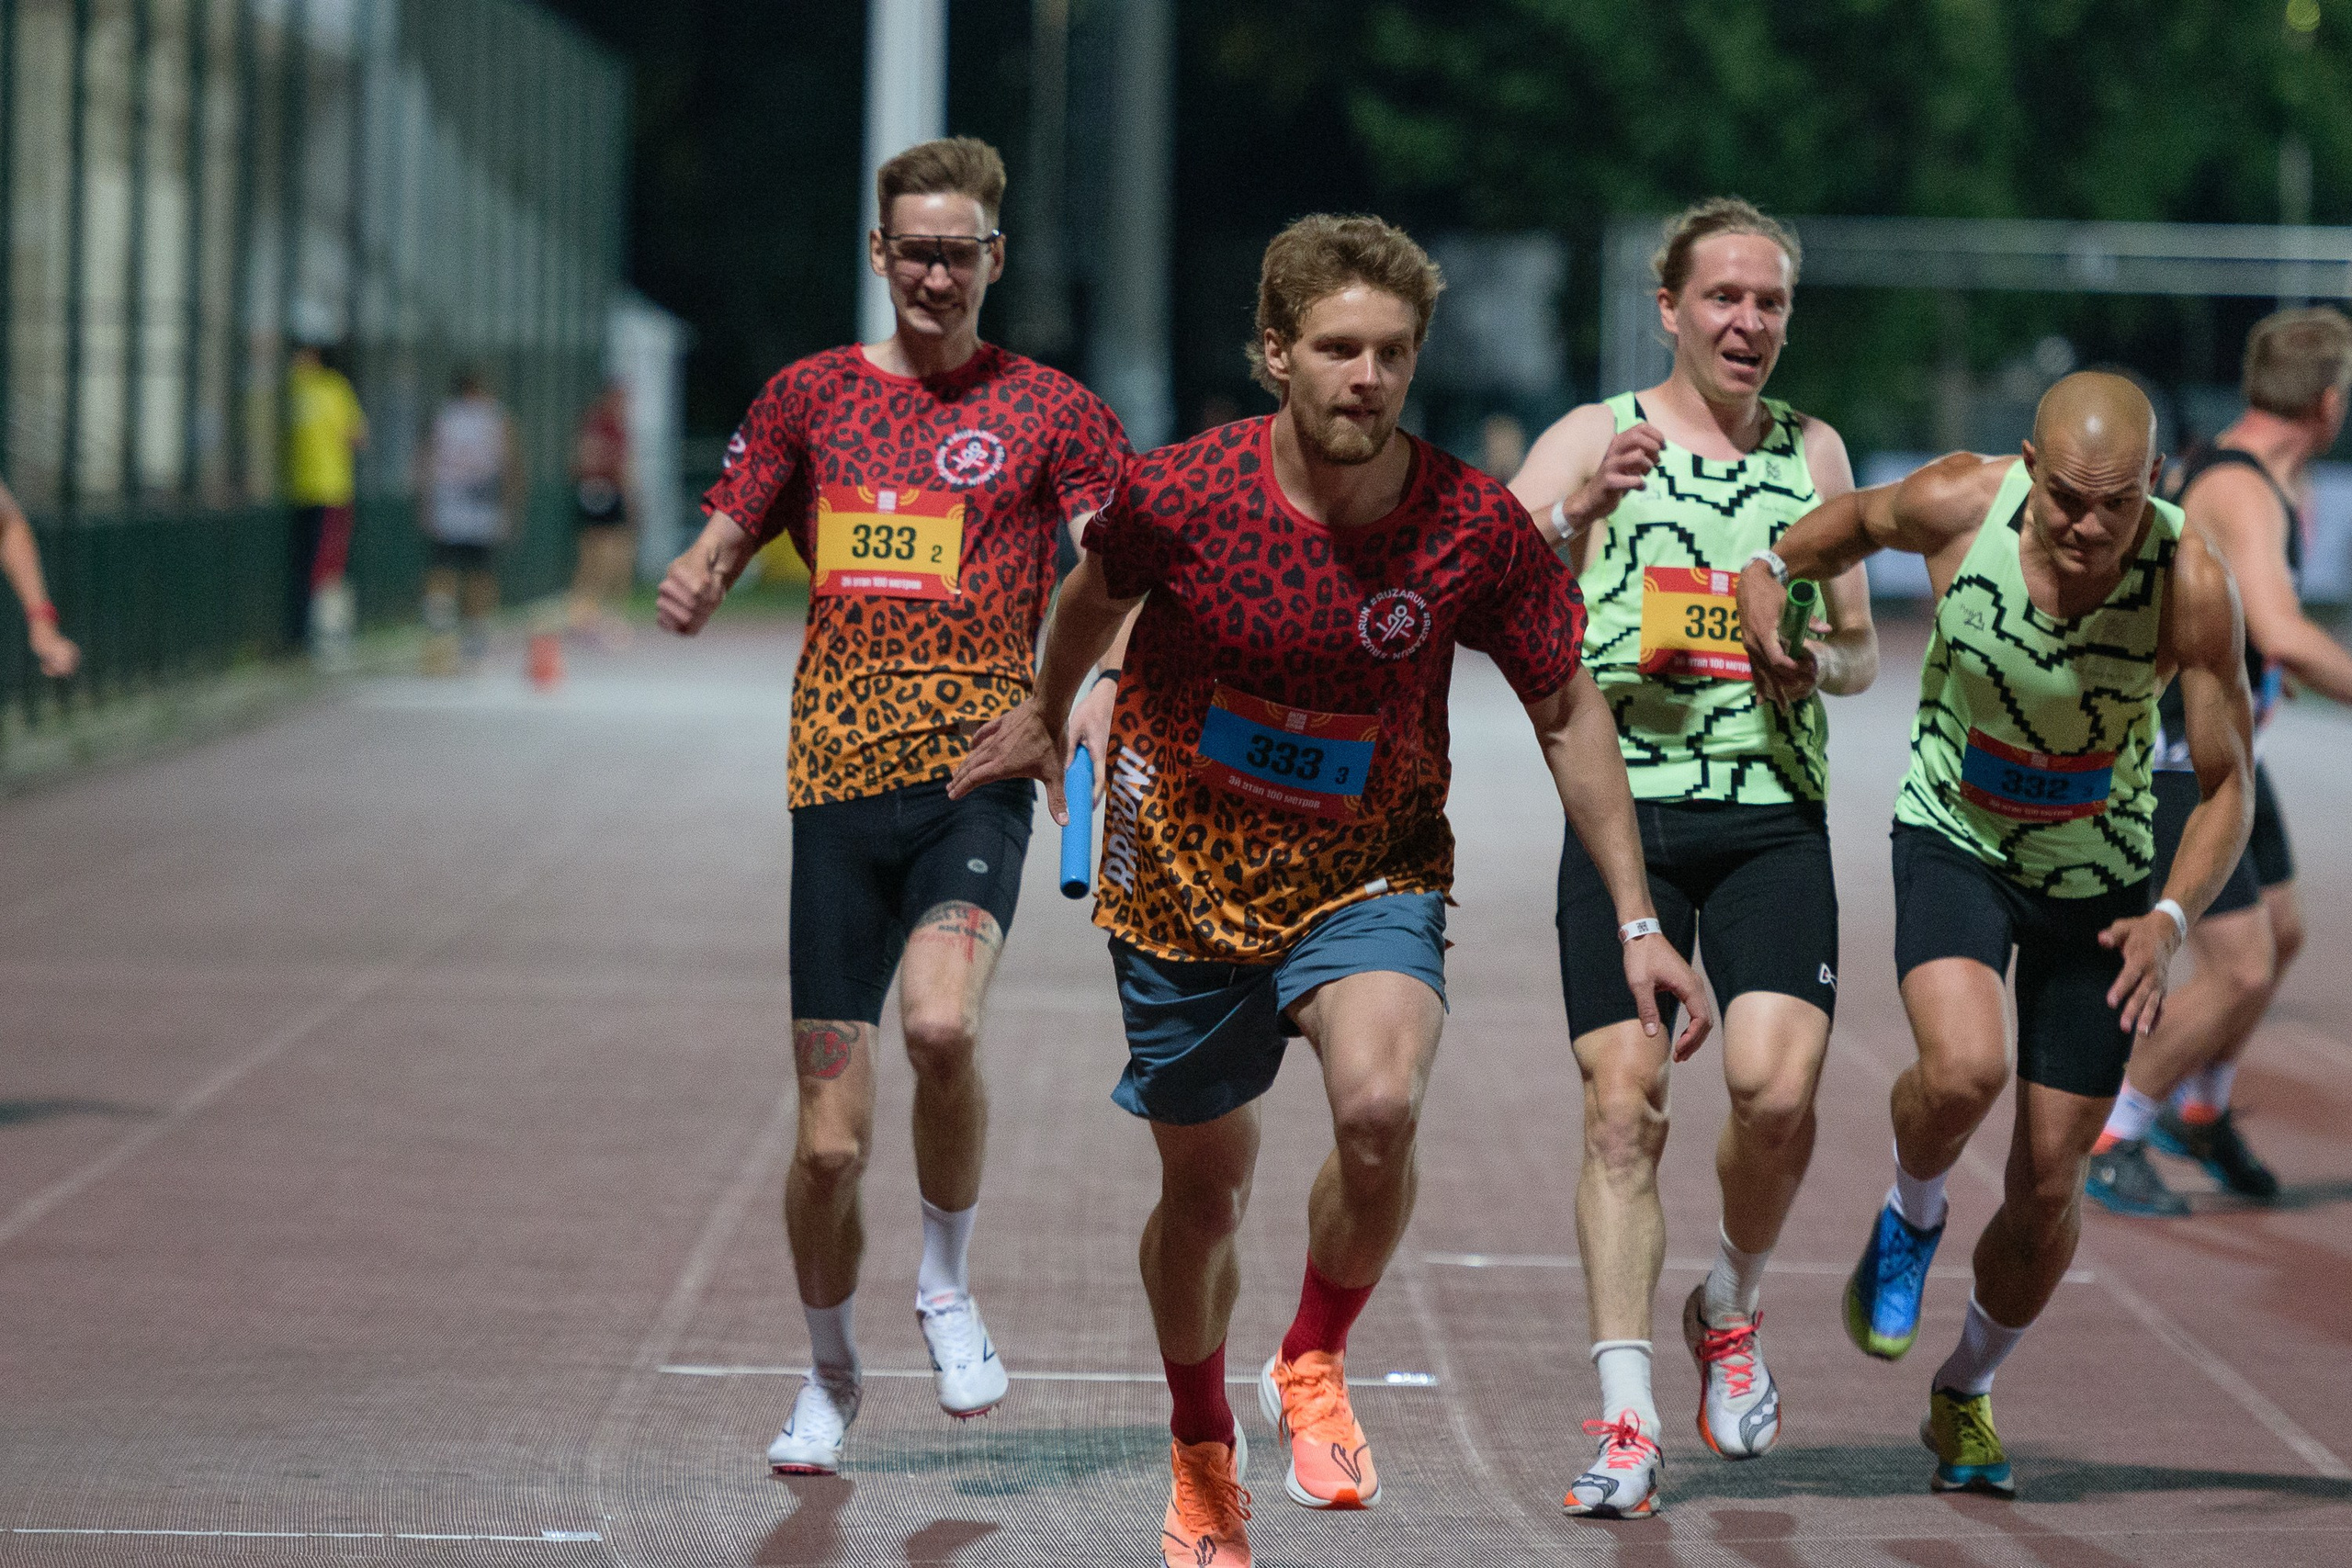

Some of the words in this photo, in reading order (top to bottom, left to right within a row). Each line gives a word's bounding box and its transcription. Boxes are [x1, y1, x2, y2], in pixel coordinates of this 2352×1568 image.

[852, 524, 917, 560] 333
[931, 545, 943, 564] 2
[1246, 734, 1324, 781] 333
[1335, 766, 1350, 784] 3
[1266, 788, 1283, 801] 100
[2002, 769, 2069, 800] 332
